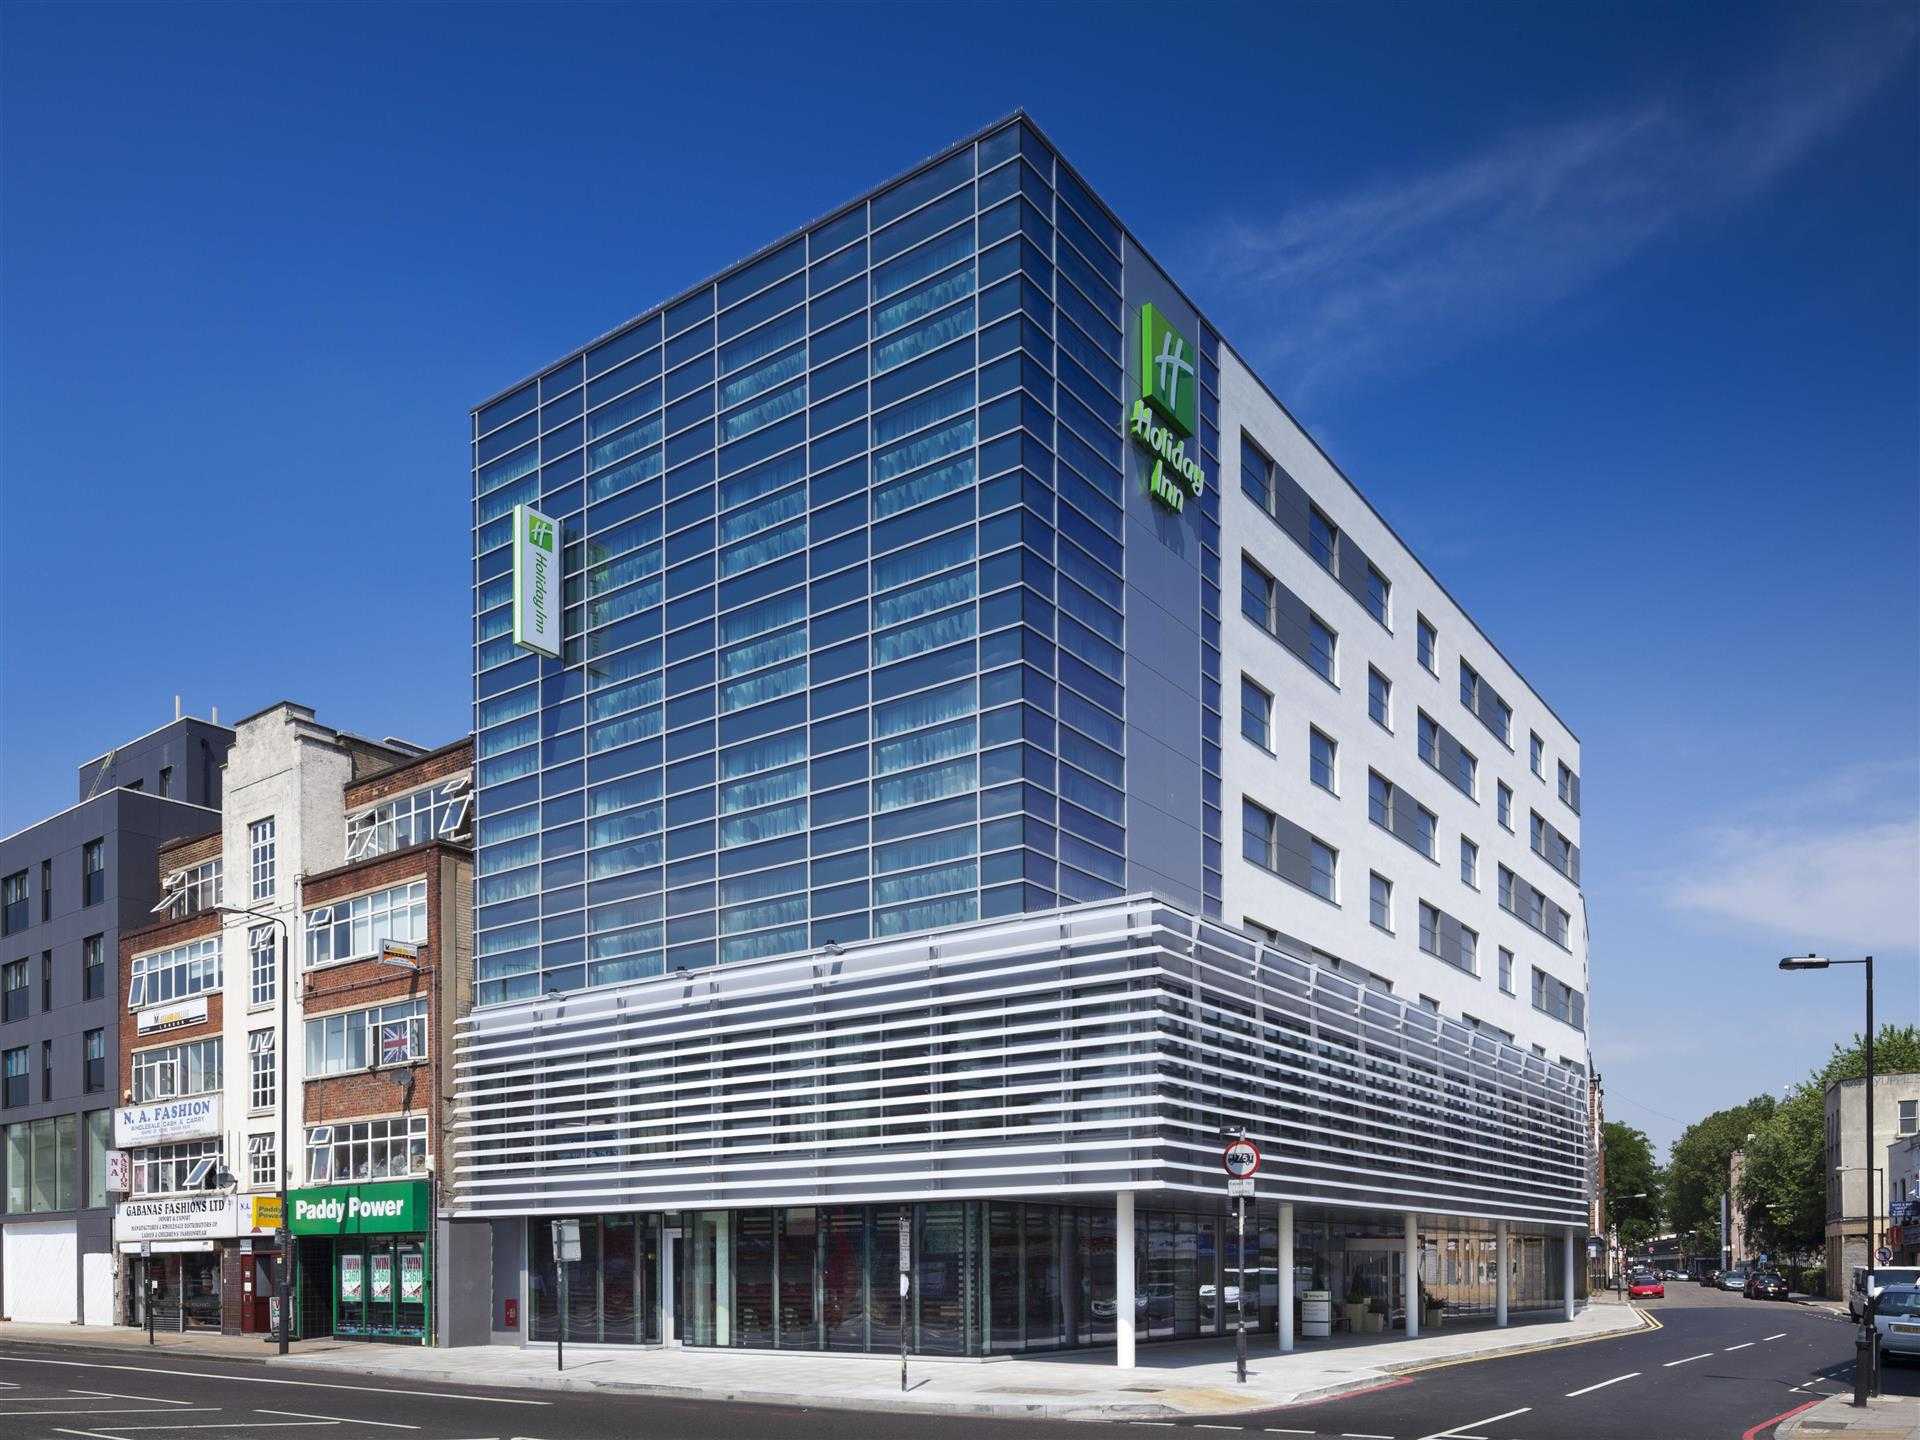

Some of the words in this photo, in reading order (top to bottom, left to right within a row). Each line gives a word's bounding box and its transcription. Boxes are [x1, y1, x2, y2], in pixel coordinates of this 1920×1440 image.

[1130, 400, 1205, 497] Holiday
[1151, 459, 1184, 514] Inn
[533, 552, 547, 608] Holiday
[536, 609, 547, 634] Inn
[155, 1100, 211, 1121] FASHION
[120, 1153, 128, 1188] FASHION
[126, 1204, 163, 1216] GABANAS
[165, 1200, 207, 1214] FASHIONS
[210, 1199, 225, 1212] LTD
[296, 1198, 345, 1222] Paddy
[348, 1197, 404, 1218] Power
[375, 1257, 389, 1270] WIN
[406, 1256, 420, 1270] WIN
